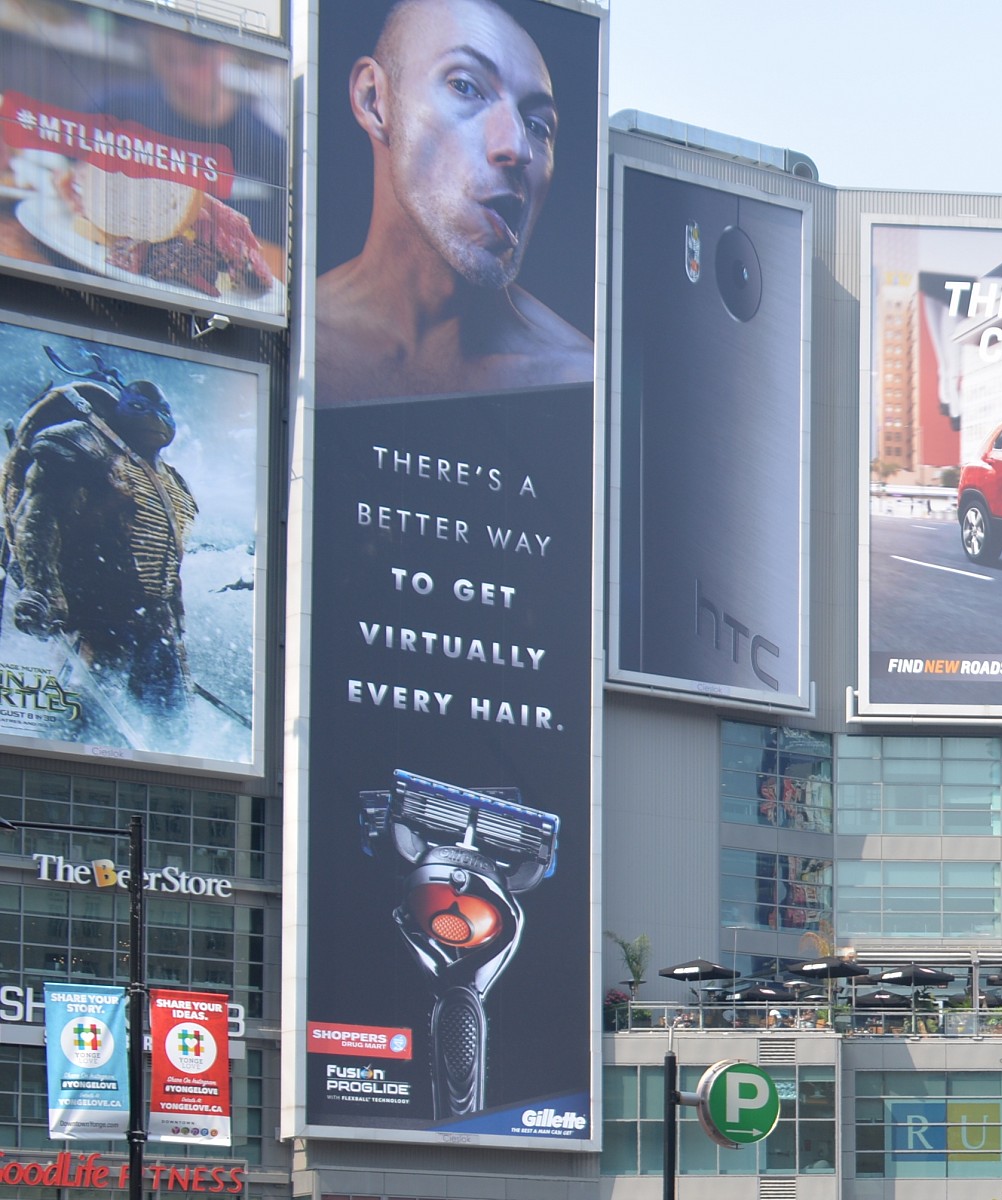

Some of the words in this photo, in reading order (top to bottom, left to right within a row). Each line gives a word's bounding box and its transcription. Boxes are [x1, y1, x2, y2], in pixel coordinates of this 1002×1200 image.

[16, 108, 219, 182] #MTLMOMENTS
[372, 446, 502, 492] THERE'S
[519, 475, 537, 498] A
[357, 502, 470, 544] BETTER
[486, 525, 551, 557] WAY
[391, 567, 434, 595] TO
[453, 578, 516, 609] GET
[359, 621, 546, 670] VIRTUALLY
[888, 658, 924, 673] FIND
[924, 659, 960, 674] NEW
[0, 669, 62, 692] INJA
[0, 686, 82, 721] RTLES
[0, 709, 26, 718] GUST
[348, 679, 453, 716] EVERY
[470, 697, 564, 732] HAIR.
[32, 853, 92, 885] The
[161, 866, 233, 898] Store
[51, 992, 88, 1004] SHARE
[88, 993, 120, 1006] YOUR
[66, 1003, 106, 1014] STORY.
[156, 998, 192, 1010] SHARE
[192, 1001, 223, 1013] YOUR
[172, 1009, 209, 1021] IDEAS.
[312, 1029, 387, 1044] SHOPPERS
[364, 1042, 387, 1050] MART
[326, 1080, 410, 1095] PROGLIDE
[726, 1071, 770, 1123] P
[160, 1102, 223, 1113] YONGELOVE.CA
[521, 1108, 586, 1130] Gillette
[0, 1152, 110, 1189] oodLife
[118, 1165, 245, 1194] FTNESS
